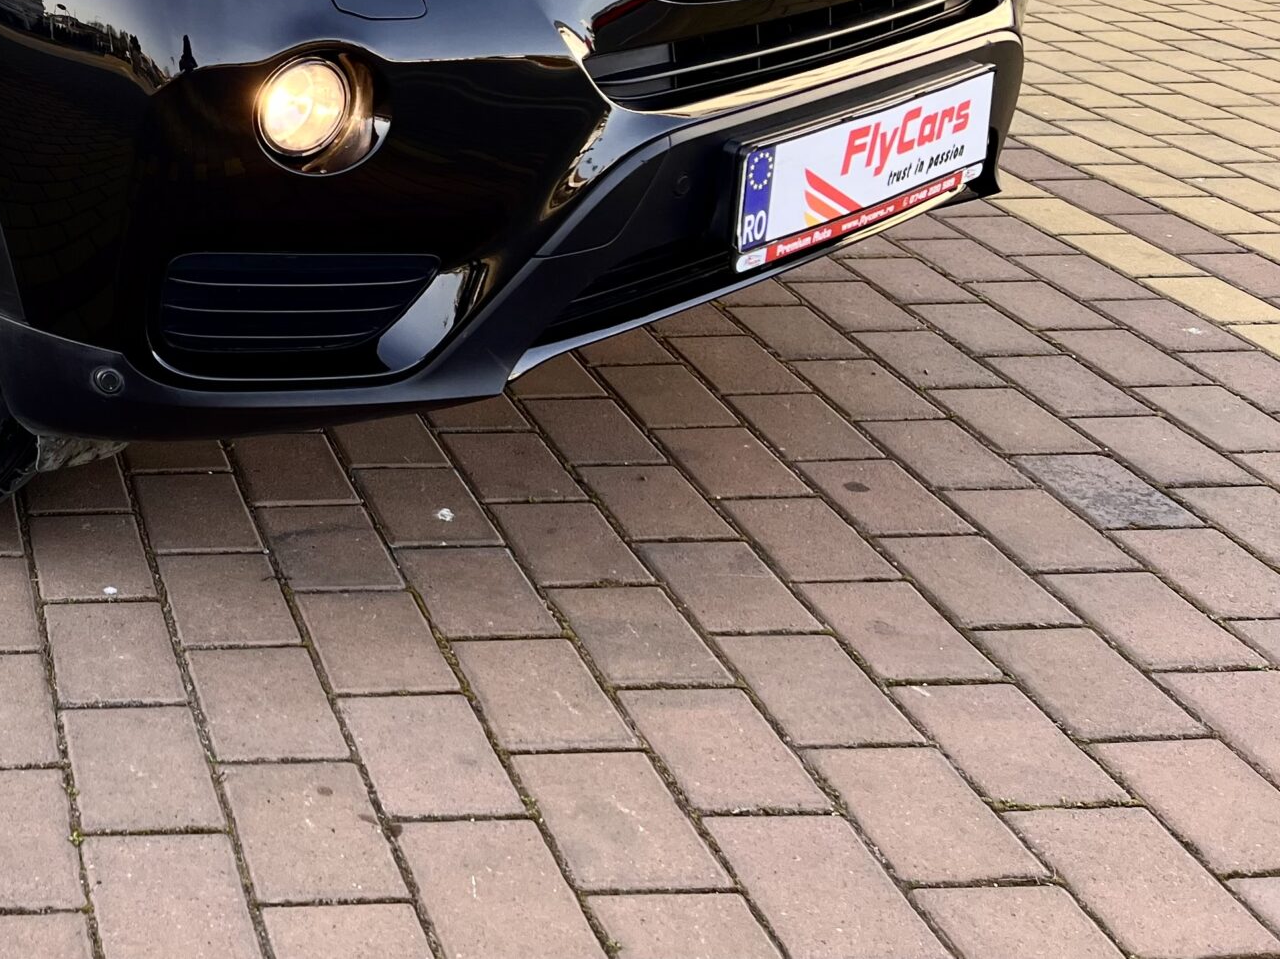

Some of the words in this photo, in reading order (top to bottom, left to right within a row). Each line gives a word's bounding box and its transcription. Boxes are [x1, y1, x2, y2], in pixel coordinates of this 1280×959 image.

[840, 99, 971, 177] FlyCars
[887, 163, 912, 186] trust
[914, 158, 925, 175] in
[926, 144, 965, 174] passion
[742, 210, 766, 245] RO
